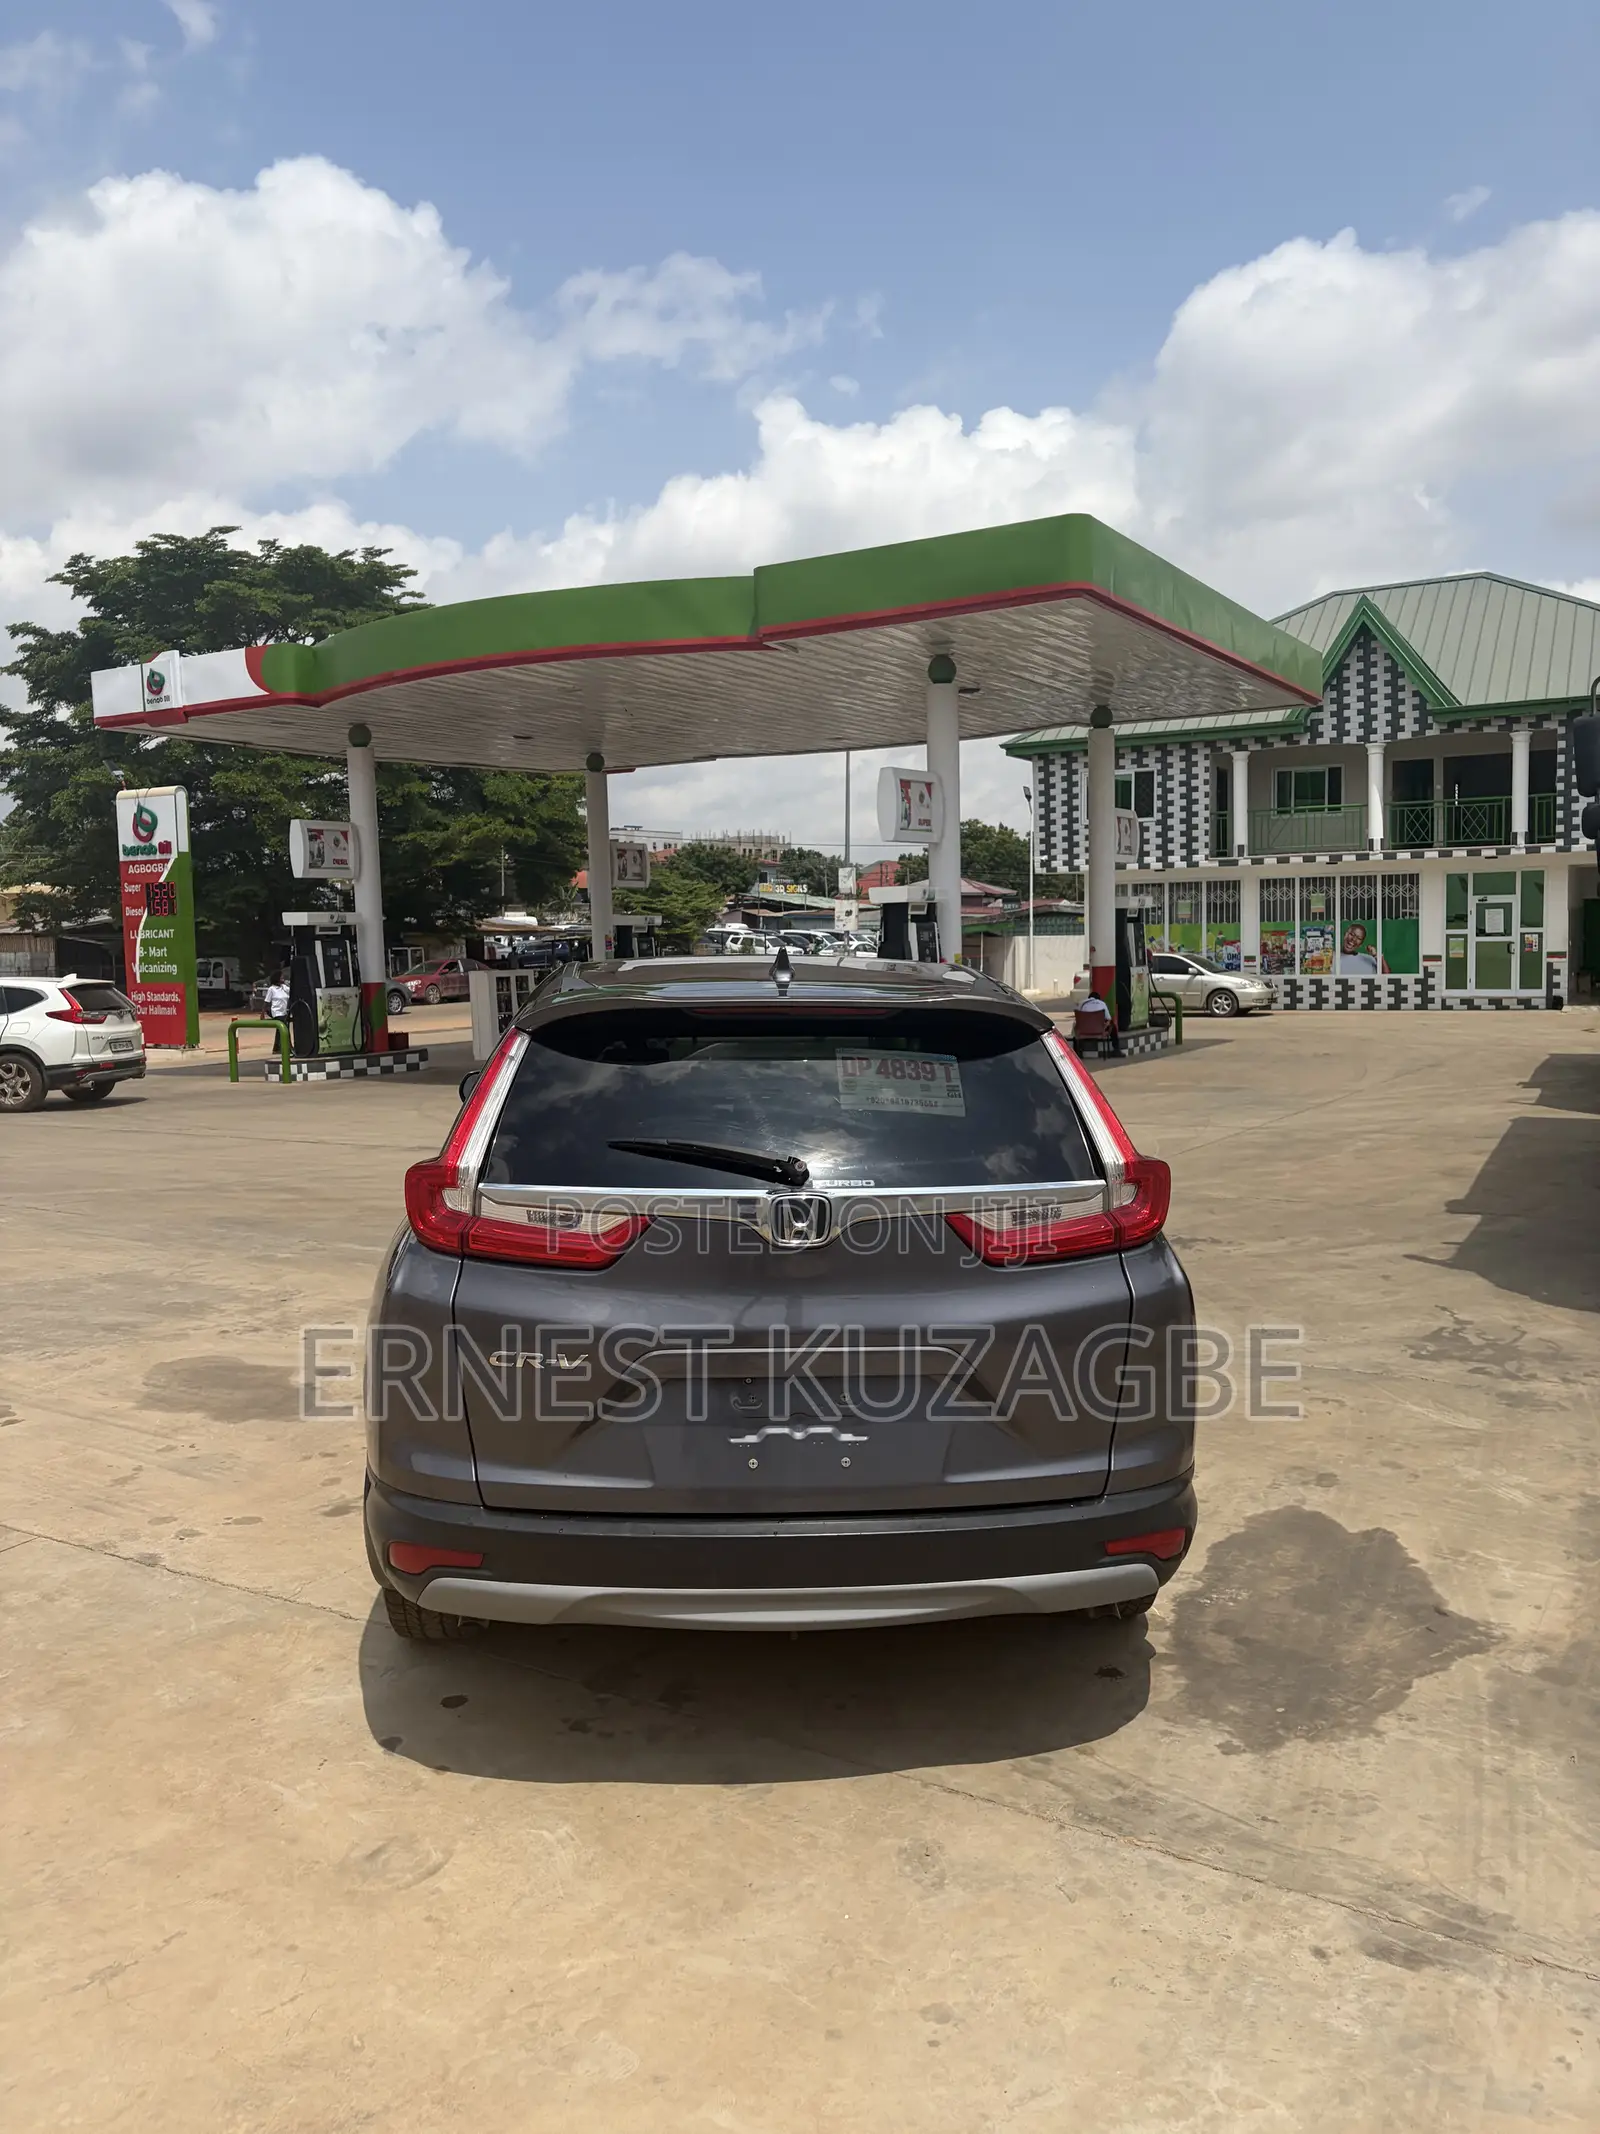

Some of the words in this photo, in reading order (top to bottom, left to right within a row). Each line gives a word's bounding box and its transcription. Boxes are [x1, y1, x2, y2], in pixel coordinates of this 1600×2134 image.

[122, 843, 157, 857] benab
[124, 883, 142, 894] Super
[125, 906, 144, 917] Diesel
[129, 928, 175, 940] LUBRICANT
[149, 945, 168, 958] Mart
[131, 962, 178, 975] Vulcanizing
[131, 991, 146, 1004] High
[136, 1005, 148, 1016] Our
[148, 1004, 177, 1016] Hallmark
[875, 1058, 937, 1081] 4839
[938, 1062, 953, 1083] T
[489, 1350, 589, 1371] CR-V
